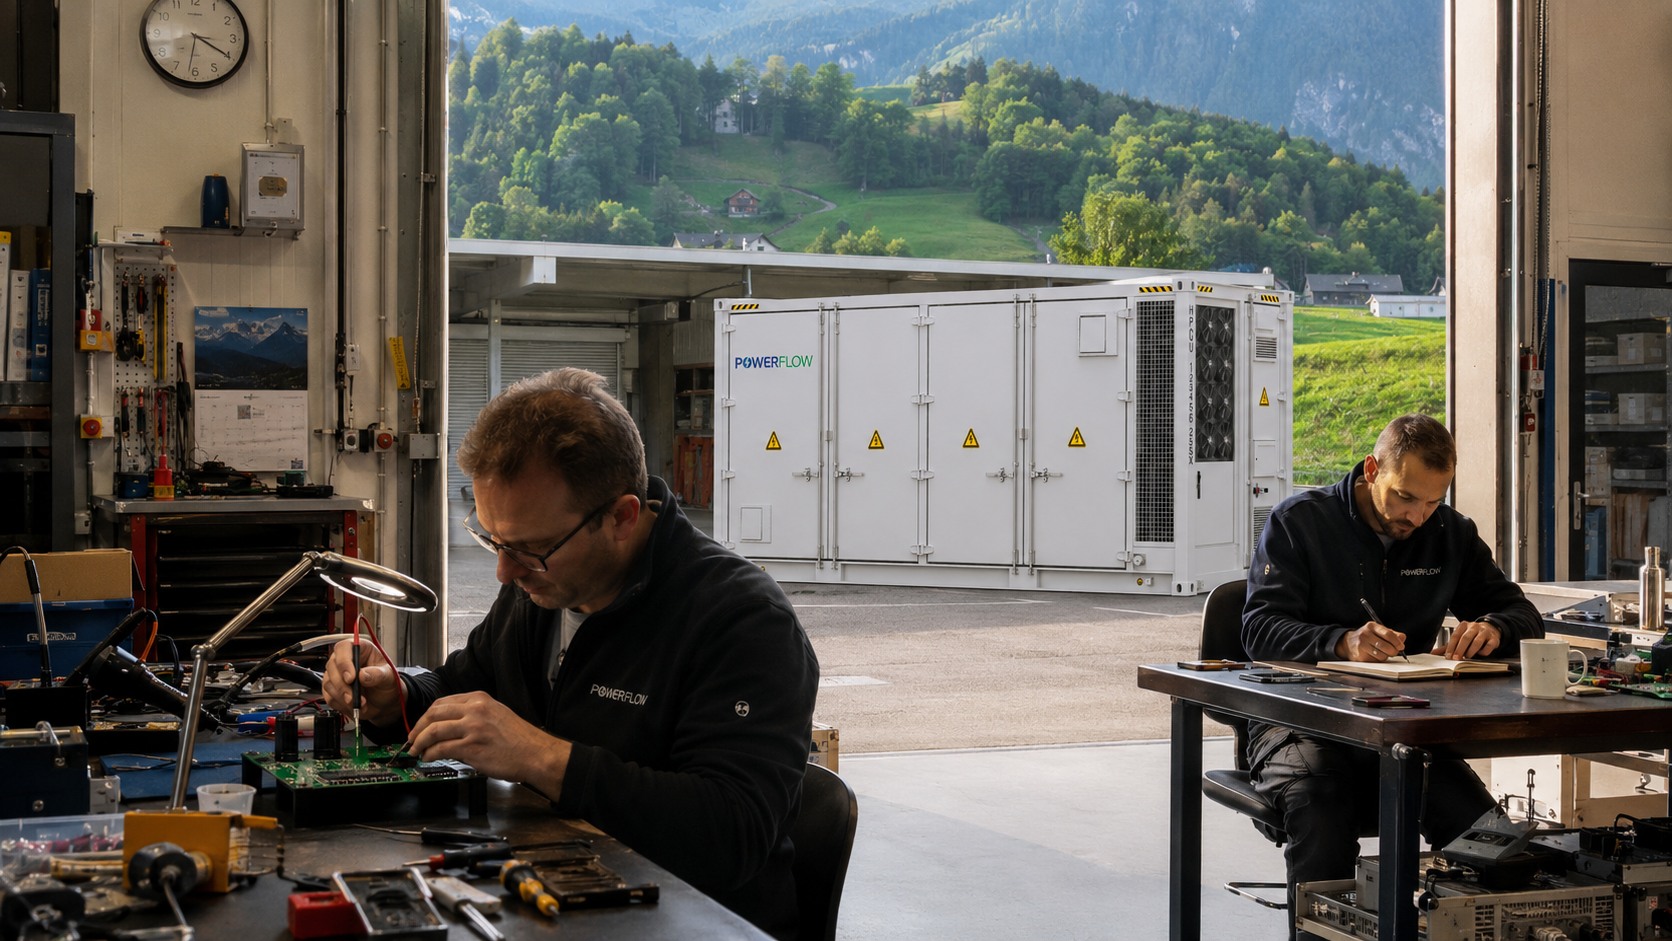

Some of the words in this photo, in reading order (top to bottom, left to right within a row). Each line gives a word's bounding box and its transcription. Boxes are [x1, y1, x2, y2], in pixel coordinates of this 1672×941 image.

[173, 0, 180, 9] 11
[212, 2, 216, 11] 1
[159, 12, 169, 21] 10
[224, 16, 231, 26] 2
[153, 28, 161, 38] 9
[229, 34, 237, 44] 3
[158, 47, 166, 57] 8
[224, 51, 231, 60] 4
[173, 60, 180, 70] 7
[210, 63, 218, 72] 5
[191, 67, 199, 77] 6
[735, 355, 813, 369] POWERFLOW
[1400, 566, 1442, 577] POWERFLOW
[590, 683, 648, 706] POWERFLOW
